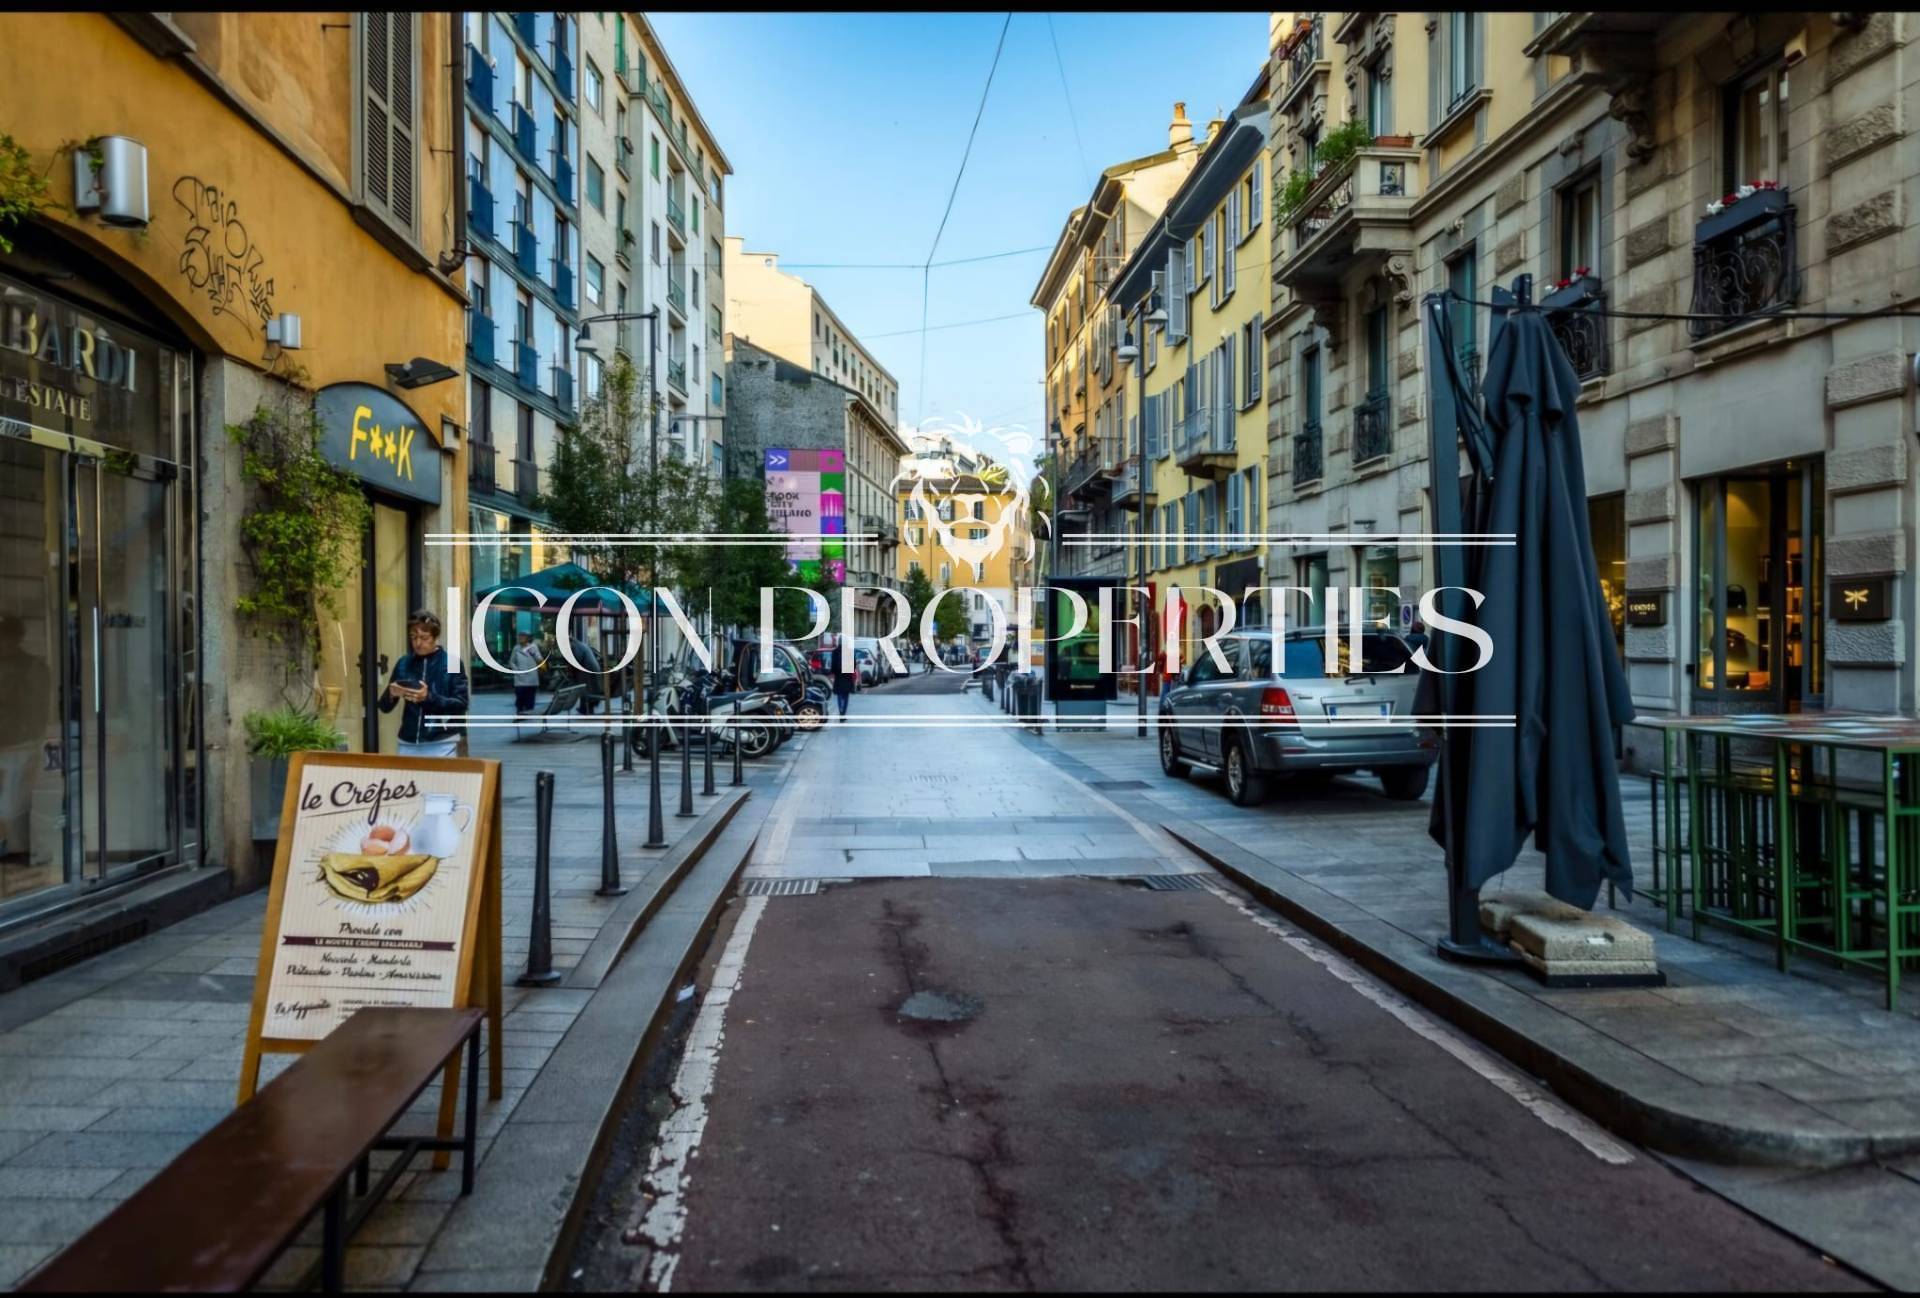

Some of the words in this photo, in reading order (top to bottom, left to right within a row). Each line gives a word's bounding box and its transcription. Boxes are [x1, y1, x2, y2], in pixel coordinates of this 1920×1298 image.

[0, 304, 137, 393] BARDI
[15, 378, 92, 422] ESTATE
[301, 782, 323, 811] le
[330, 778, 420, 826] Crêpes
